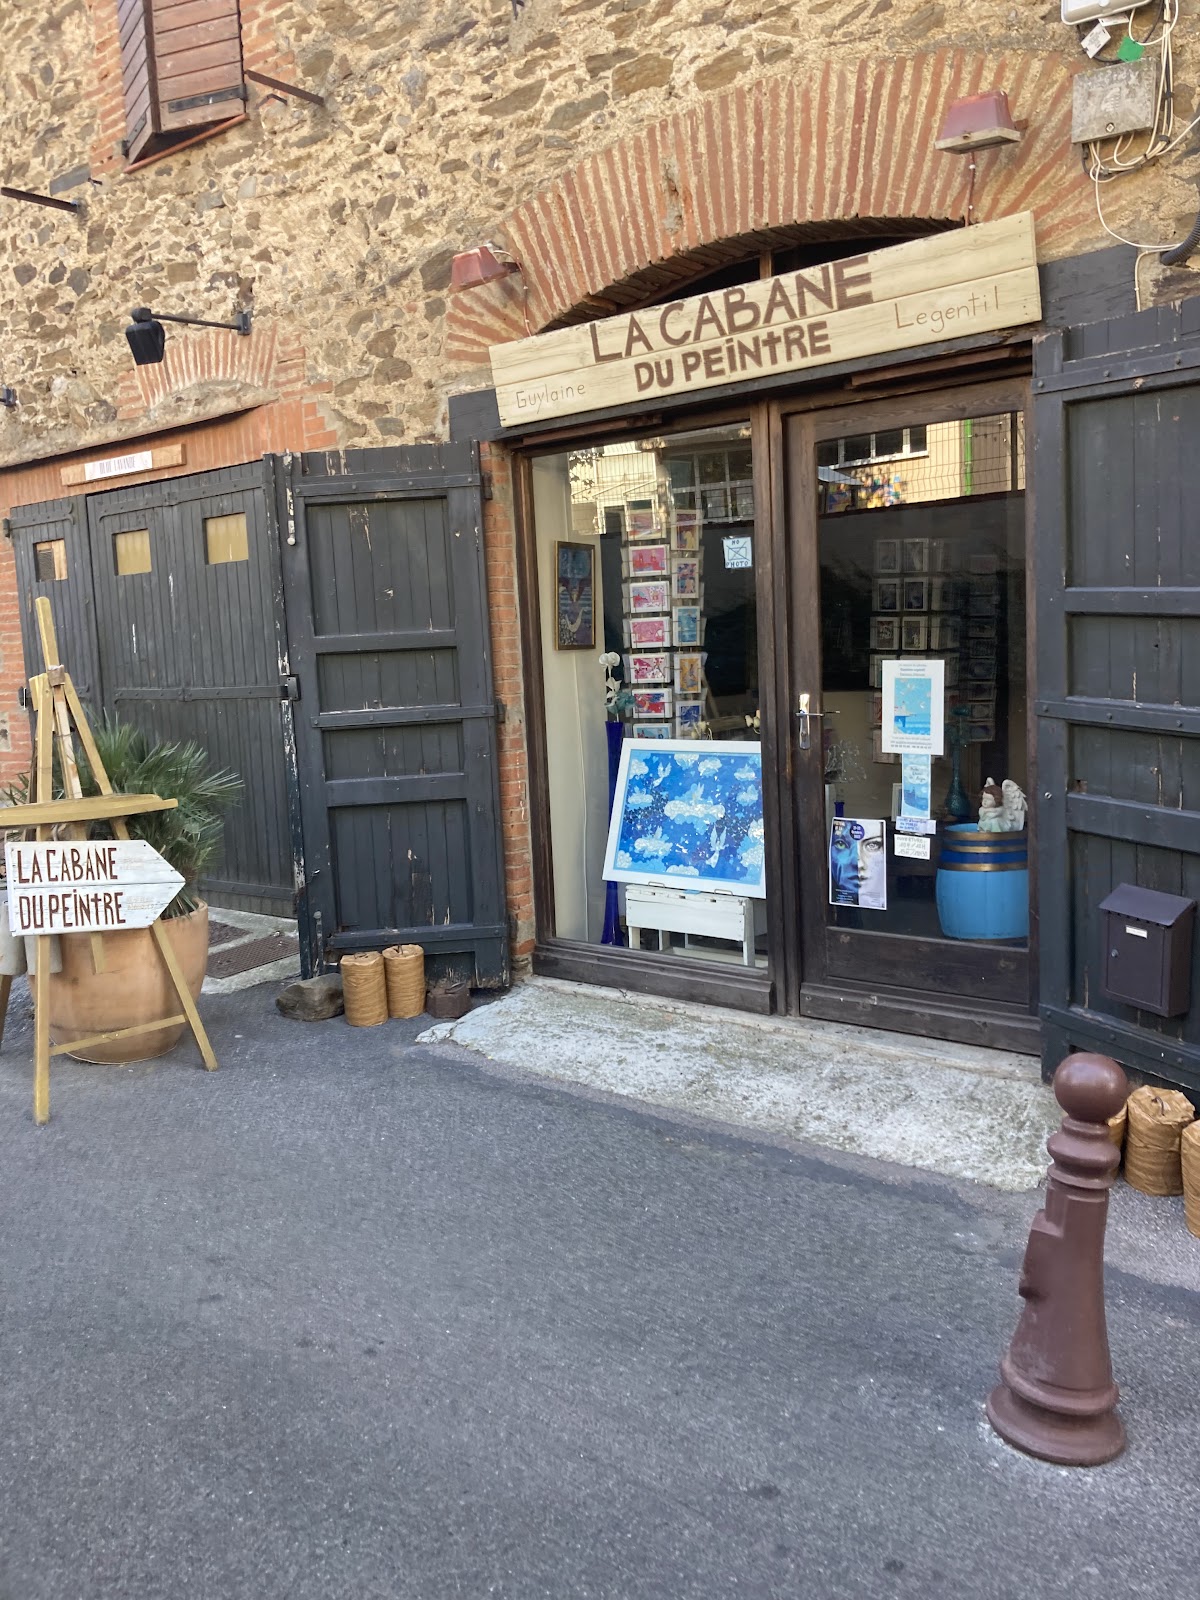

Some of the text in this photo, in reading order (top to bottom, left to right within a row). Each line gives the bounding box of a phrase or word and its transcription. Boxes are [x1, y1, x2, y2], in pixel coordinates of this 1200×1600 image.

[589, 256, 874, 363] LA CABANE
[894, 285, 999, 333] Legentil
[634, 358, 674, 393] DU
[516, 384, 586, 415] Guylaine
[17, 850, 43, 884] LA
[46, 847, 118, 882] CABANE
[18, 895, 44, 930] DU
